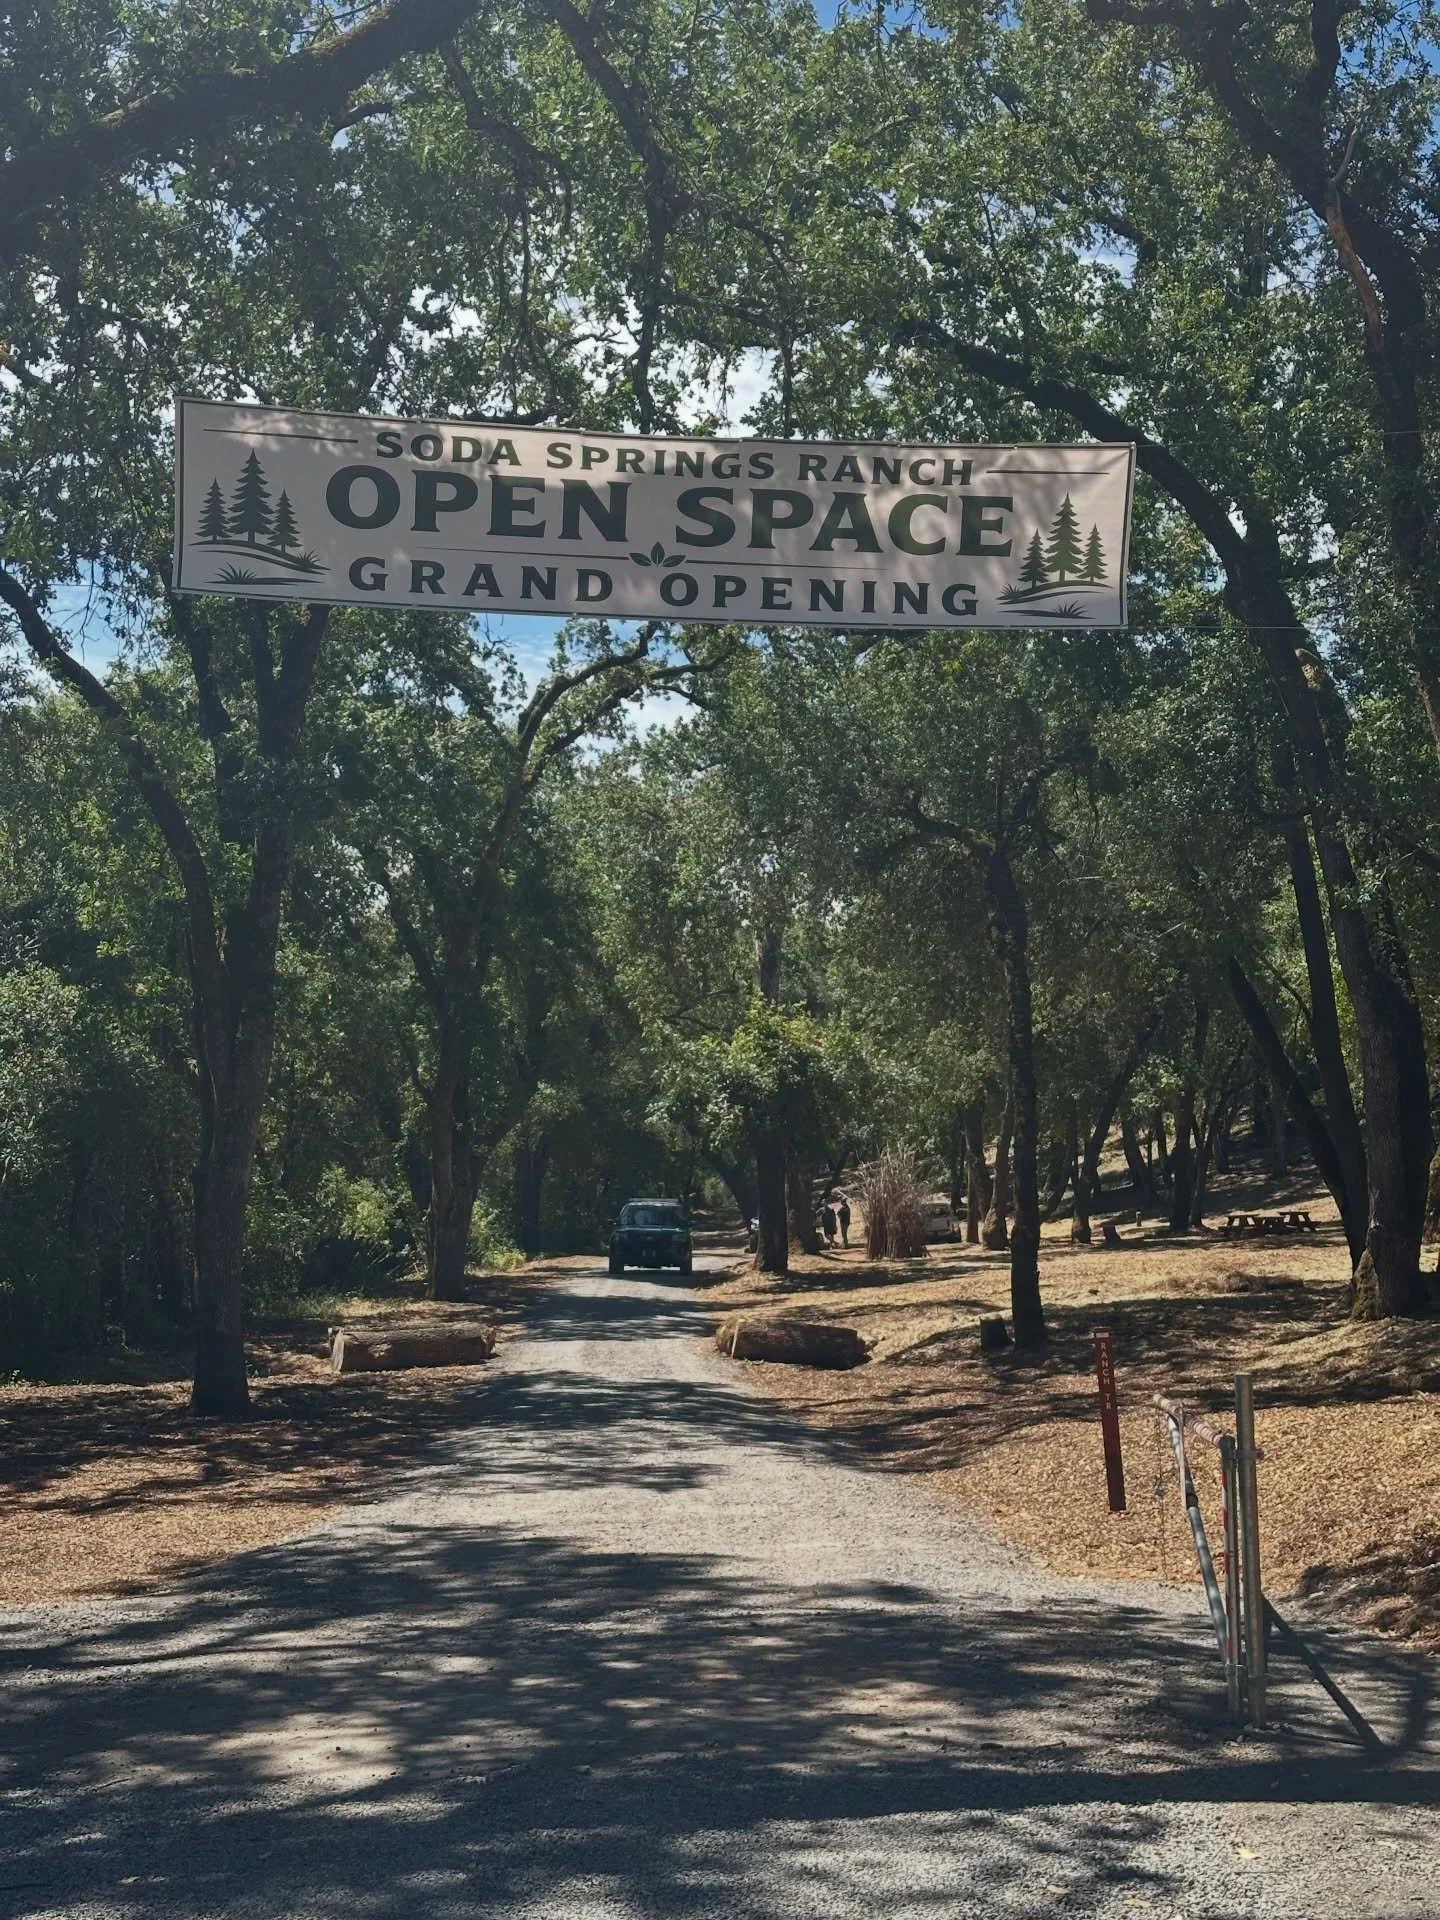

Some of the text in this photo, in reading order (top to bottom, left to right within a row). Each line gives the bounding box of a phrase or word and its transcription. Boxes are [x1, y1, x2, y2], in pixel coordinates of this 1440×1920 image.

[376, 431, 973, 486] SODA SPRINGS RANCH
[326, 464, 1014, 557] OPEN SPACE
[349, 556, 978, 616] GRAND OPENING
[1101, 1342, 1110, 1385] RANCH
